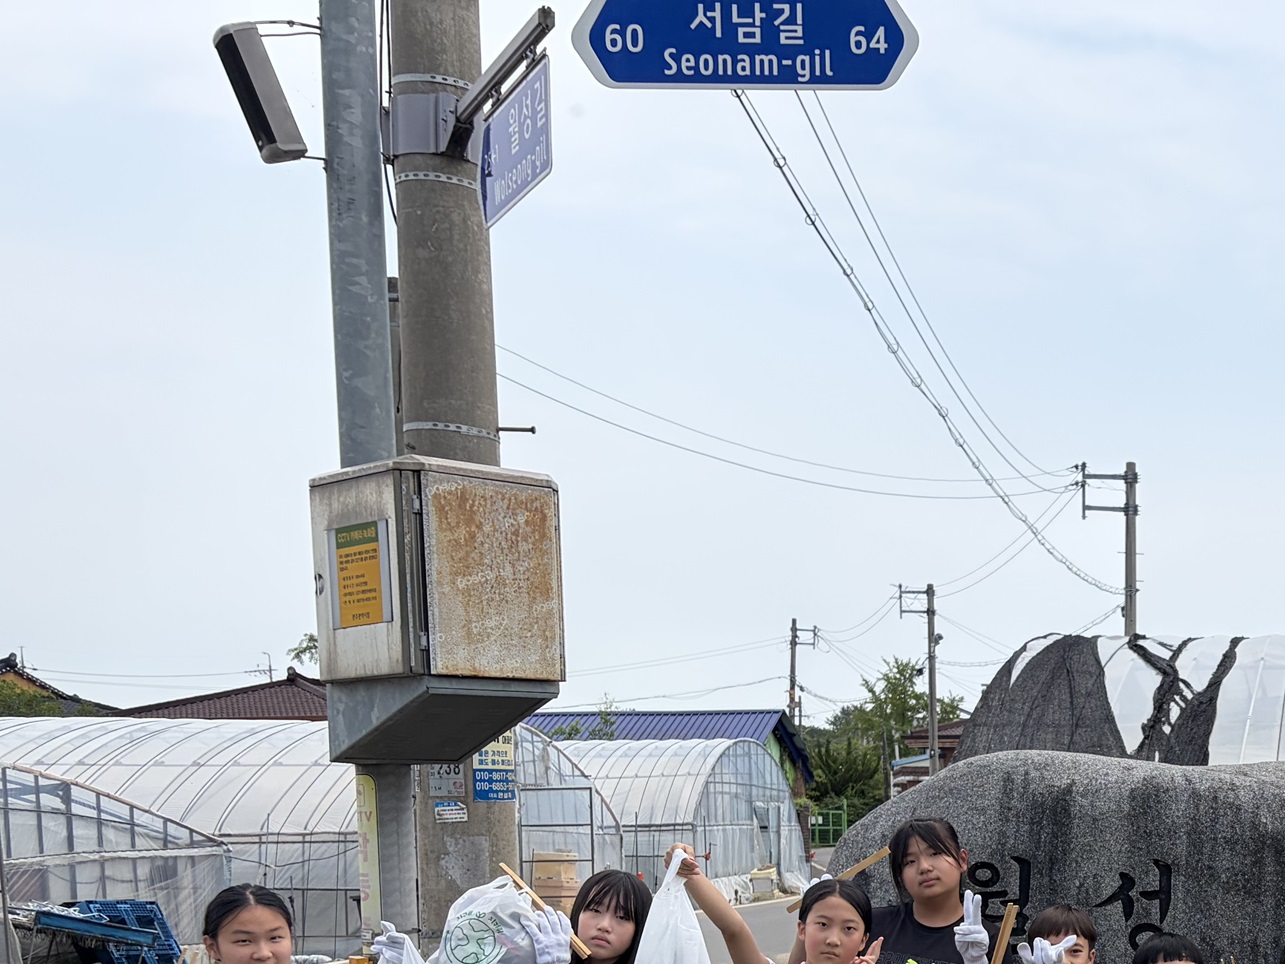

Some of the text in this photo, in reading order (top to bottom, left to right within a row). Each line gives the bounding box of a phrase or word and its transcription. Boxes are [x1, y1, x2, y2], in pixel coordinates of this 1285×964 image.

[604, 23, 645, 53] 60
[689, 1, 805, 45] 서남길
[849, 26, 889, 55] 64
[663, 48, 834, 82] Seonam-gil
[508, 75, 547, 155] 월성길
[493, 134, 548, 206] Wolseong-gil
[966, 855, 1174, 956] 월성
